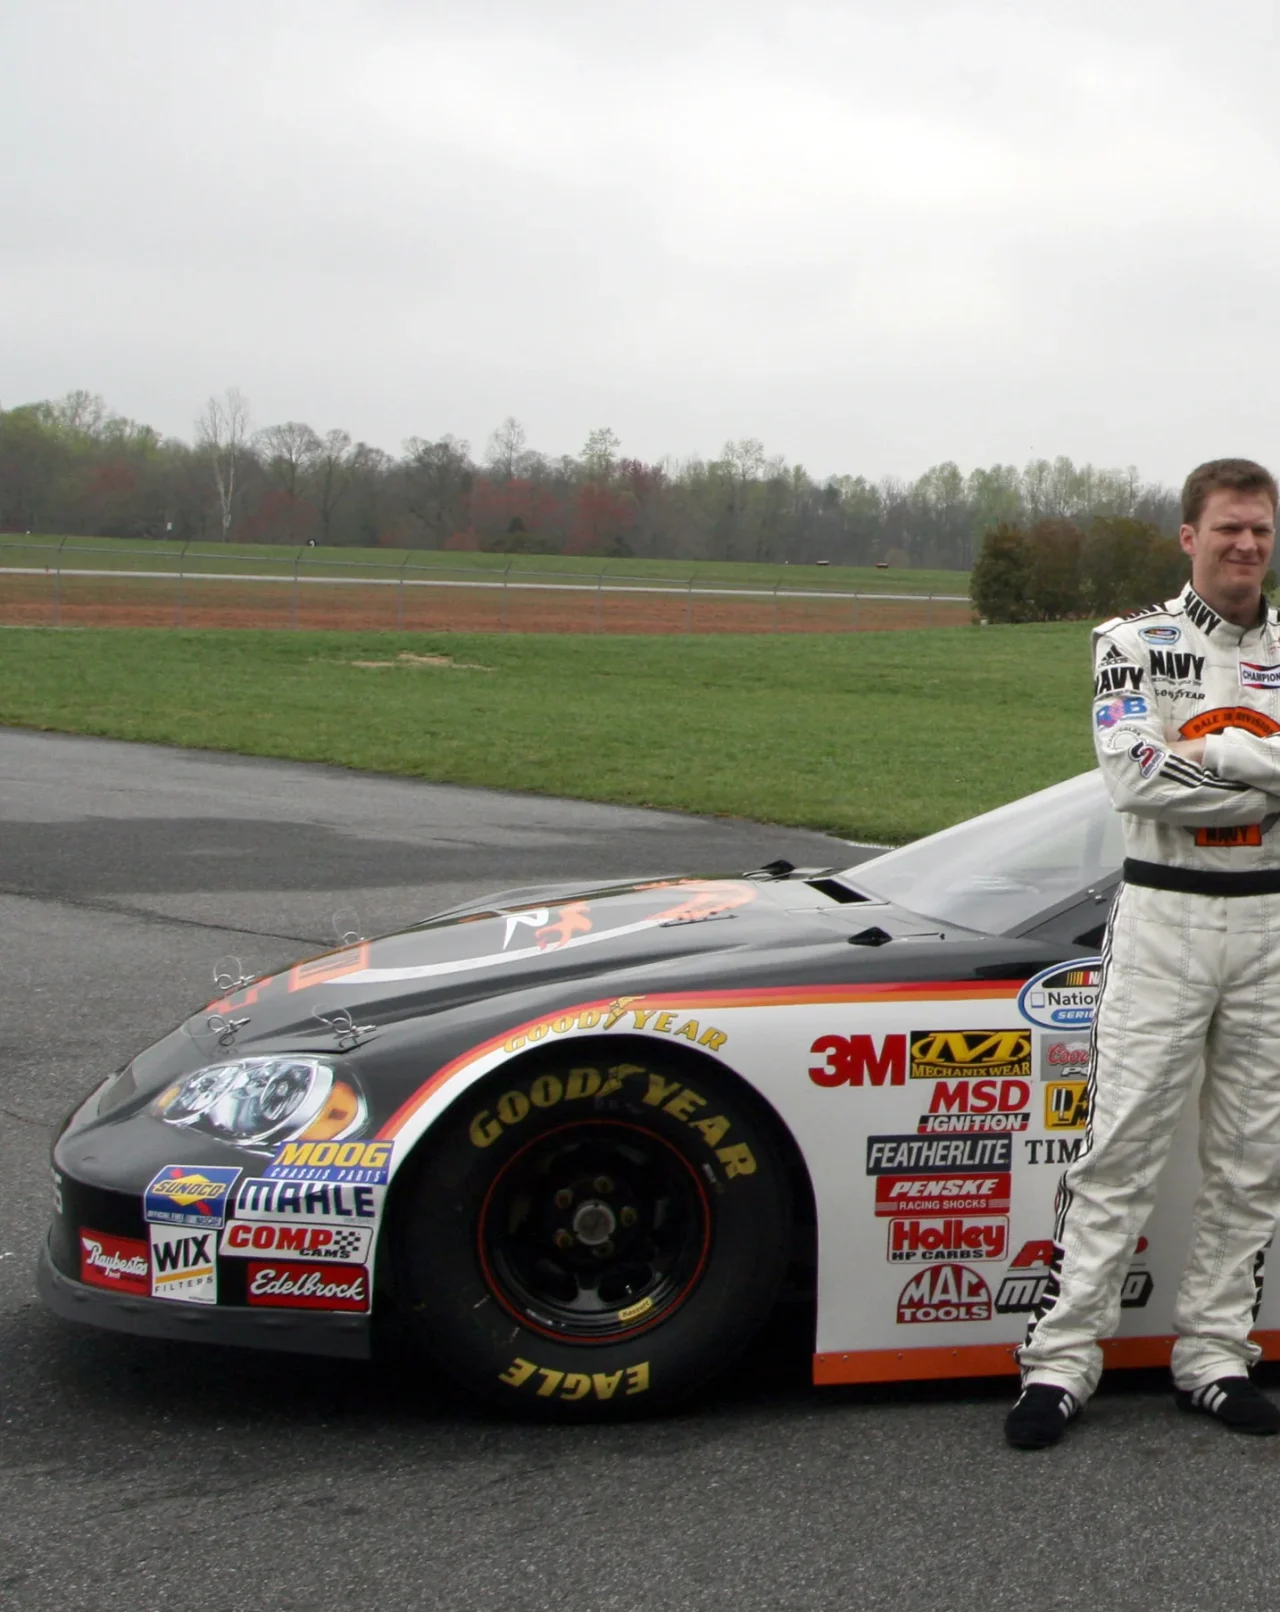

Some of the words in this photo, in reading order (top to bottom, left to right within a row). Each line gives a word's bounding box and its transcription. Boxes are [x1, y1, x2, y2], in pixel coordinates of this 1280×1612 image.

[1184, 591, 1221, 636] NAVY
[1149, 650, 1205, 680] NAVY
[1095, 667, 1144, 698] AVY
[808, 1034, 906, 1087] 3M
[912, 1063, 988, 1079] MECHANIX
[990, 1061, 1031, 1077] WEAR
[928, 1080, 1030, 1114] MSD
[926, 1115, 1023, 1133] IGNITION
[274, 1143, 392, 1167] MOOG
[869, 1139, 1009, 1169] FEATHERLITE
[154, 1181, 225, 1197] SUNOCO
[271, 1167, 330, 1180] CHASSIS
[338, 1169, 382, 1182] PARTS
[889, 1178, 999, 1197] PENSKE
[238, 1180, 376, 1218] MAHLE
[900, 1200, 940, 1211] RACING
[942, 1199, 987, 1210] SHOCKS
[153, 1233, 213, 1272] WIX
[228, 1224, 334, 1251] COMP
[892, 1219, 1005, 1258] Holley
[86, 1244, 148, 1277] Raybestos
[299, 1248, 351, 1259] CAMS
[892, 1251, 917, 1261] HP
[922, 1249, 983, 1260] CARBS
[155, 1276, 214, 1294] FILTERS
[250, 1269, 365, 1301] Edelbrock
[901, 1264, 988, 1305] MAC
[900, 1305, 989, 1321] TOOLS
[498, 1356, 650, 1401] EAGLE
